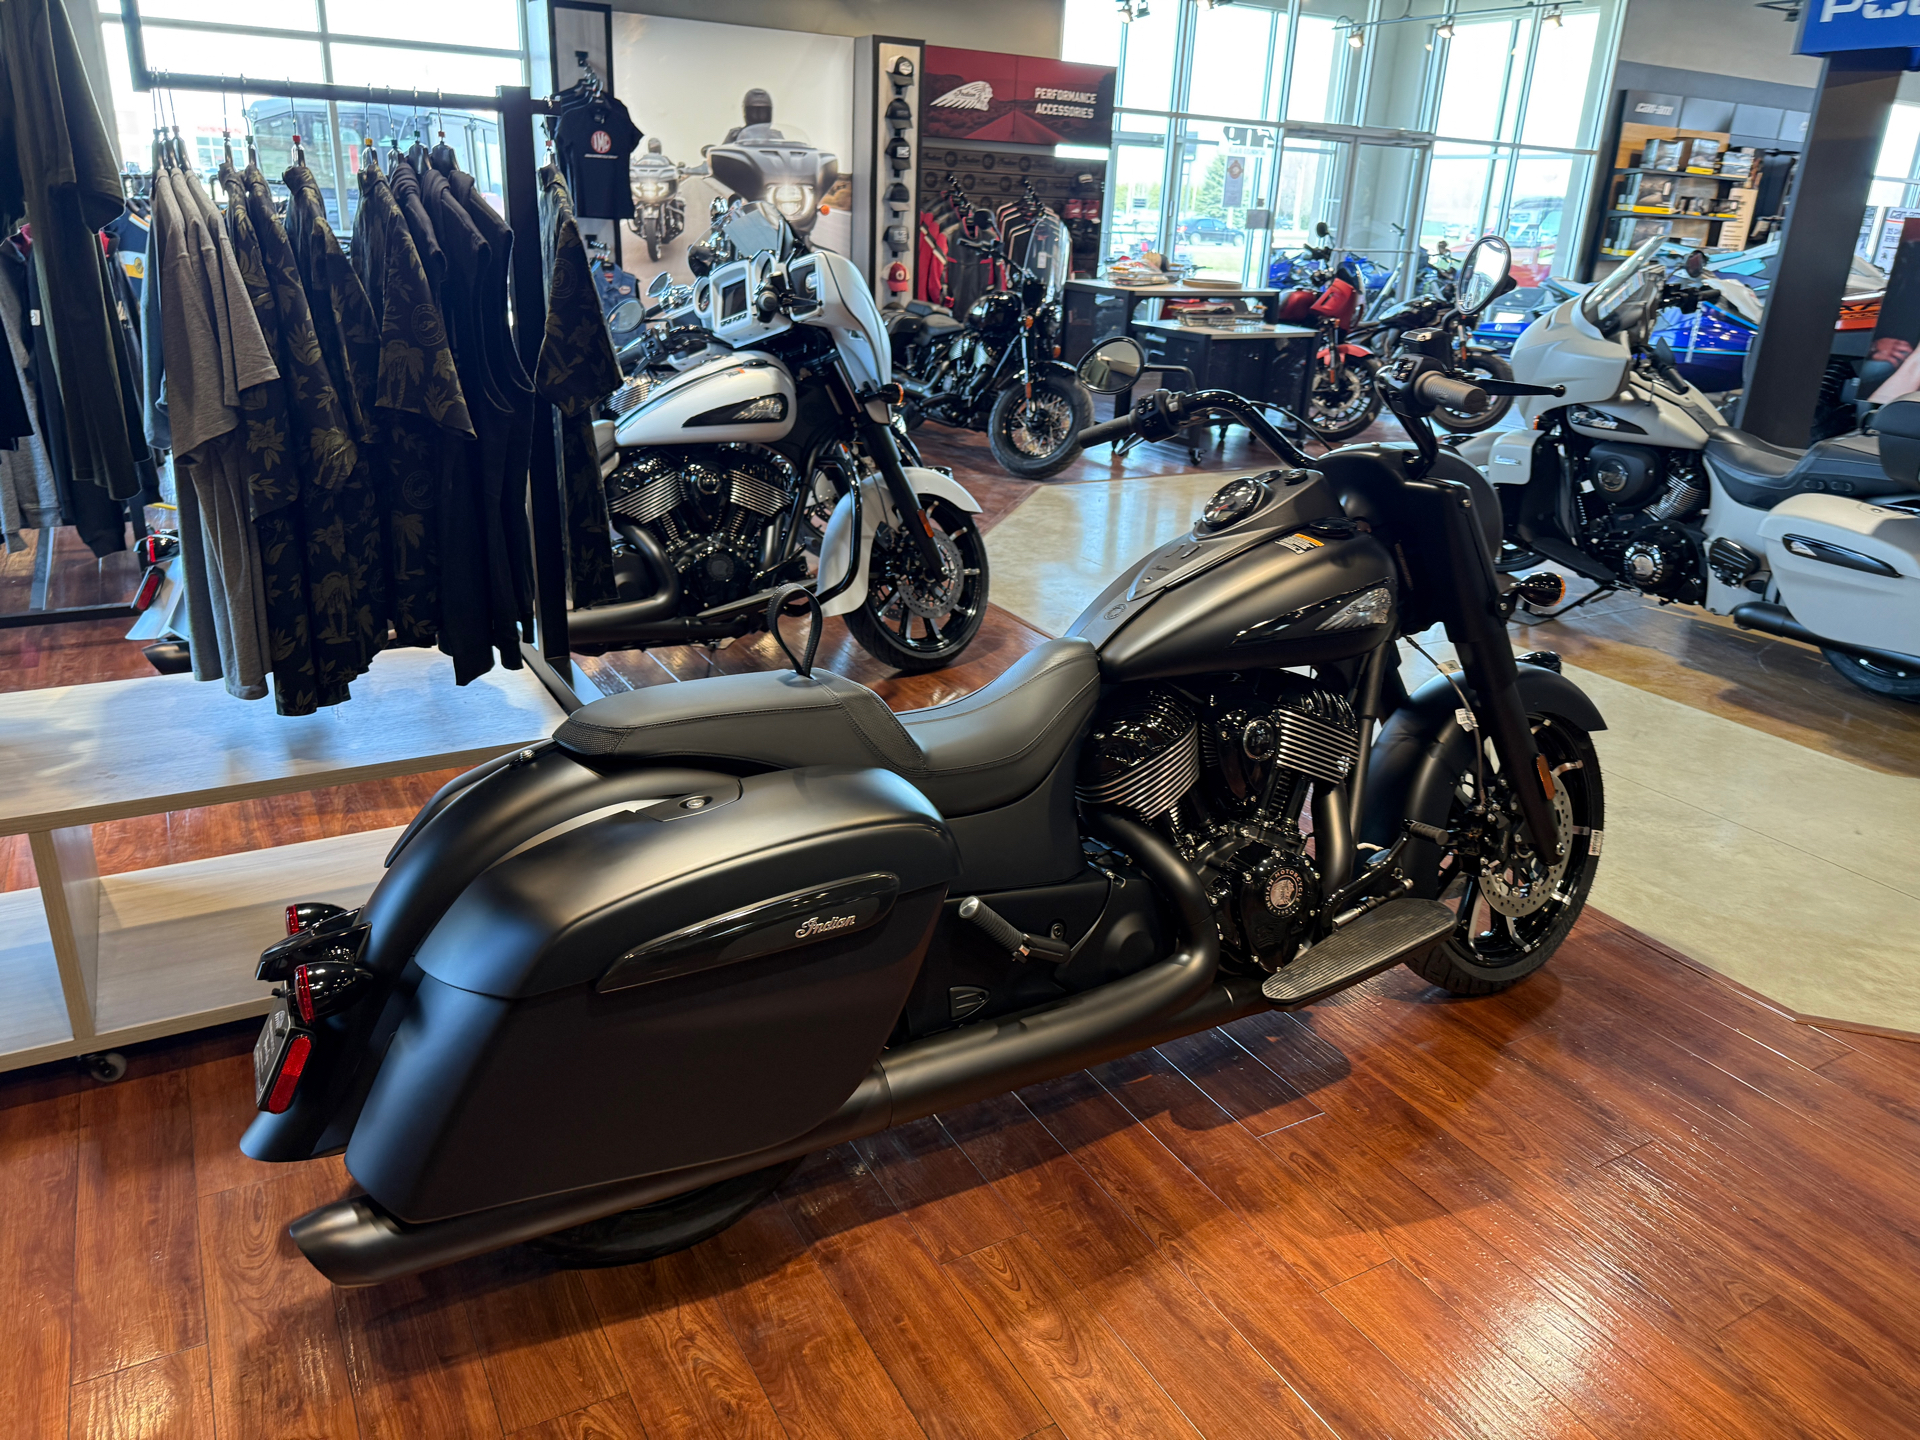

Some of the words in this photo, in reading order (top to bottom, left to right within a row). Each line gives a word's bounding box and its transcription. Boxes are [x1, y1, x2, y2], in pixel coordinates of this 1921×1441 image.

[1034, 87, 1098, 105] PERFORMANCE
[1034, 103, 1095, 119] ACCESSORIES
[795, 915, 856, 939] Indian
